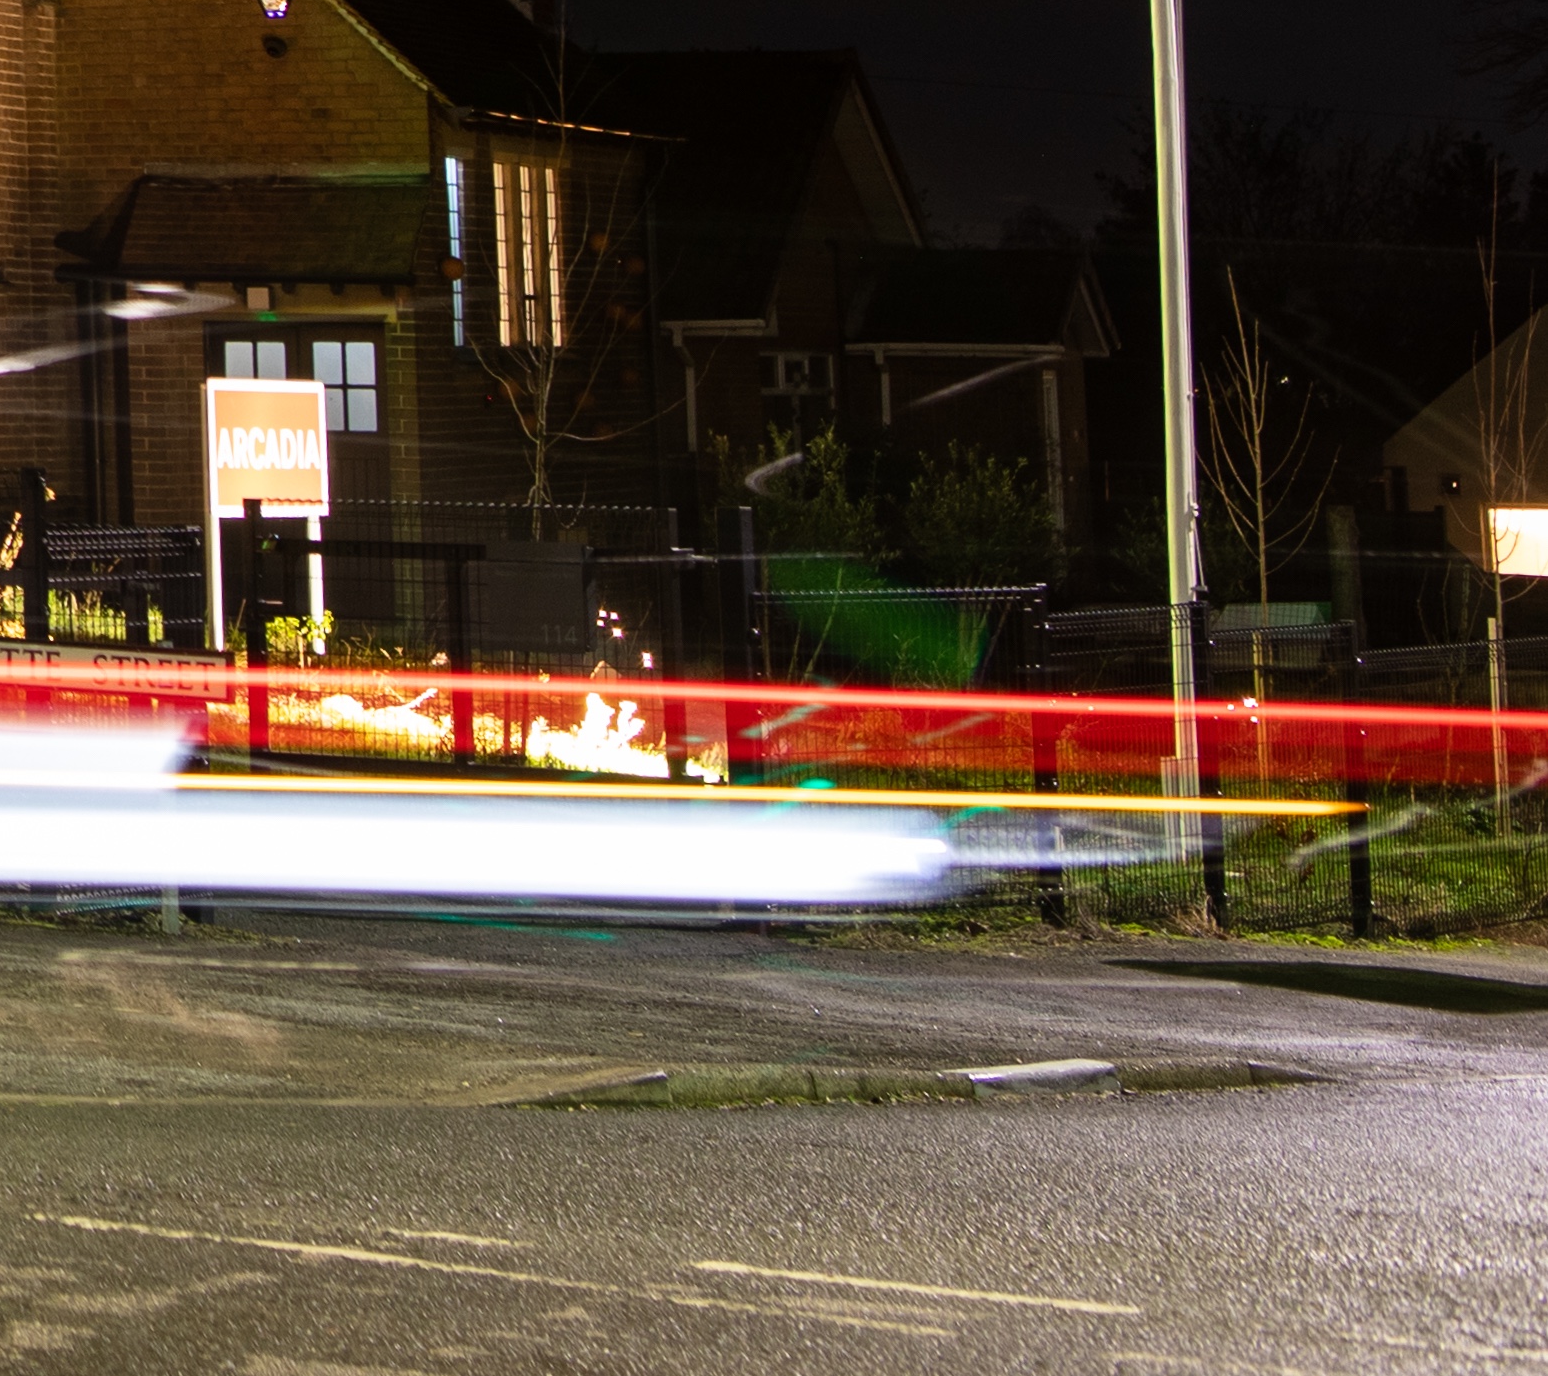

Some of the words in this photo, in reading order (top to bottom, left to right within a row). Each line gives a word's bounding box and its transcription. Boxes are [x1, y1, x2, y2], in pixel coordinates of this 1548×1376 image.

[217, 426, 321, 470] ARCADIA
[541, 624, 578, 645] 114
[91, 653, 216, 694] STREET
